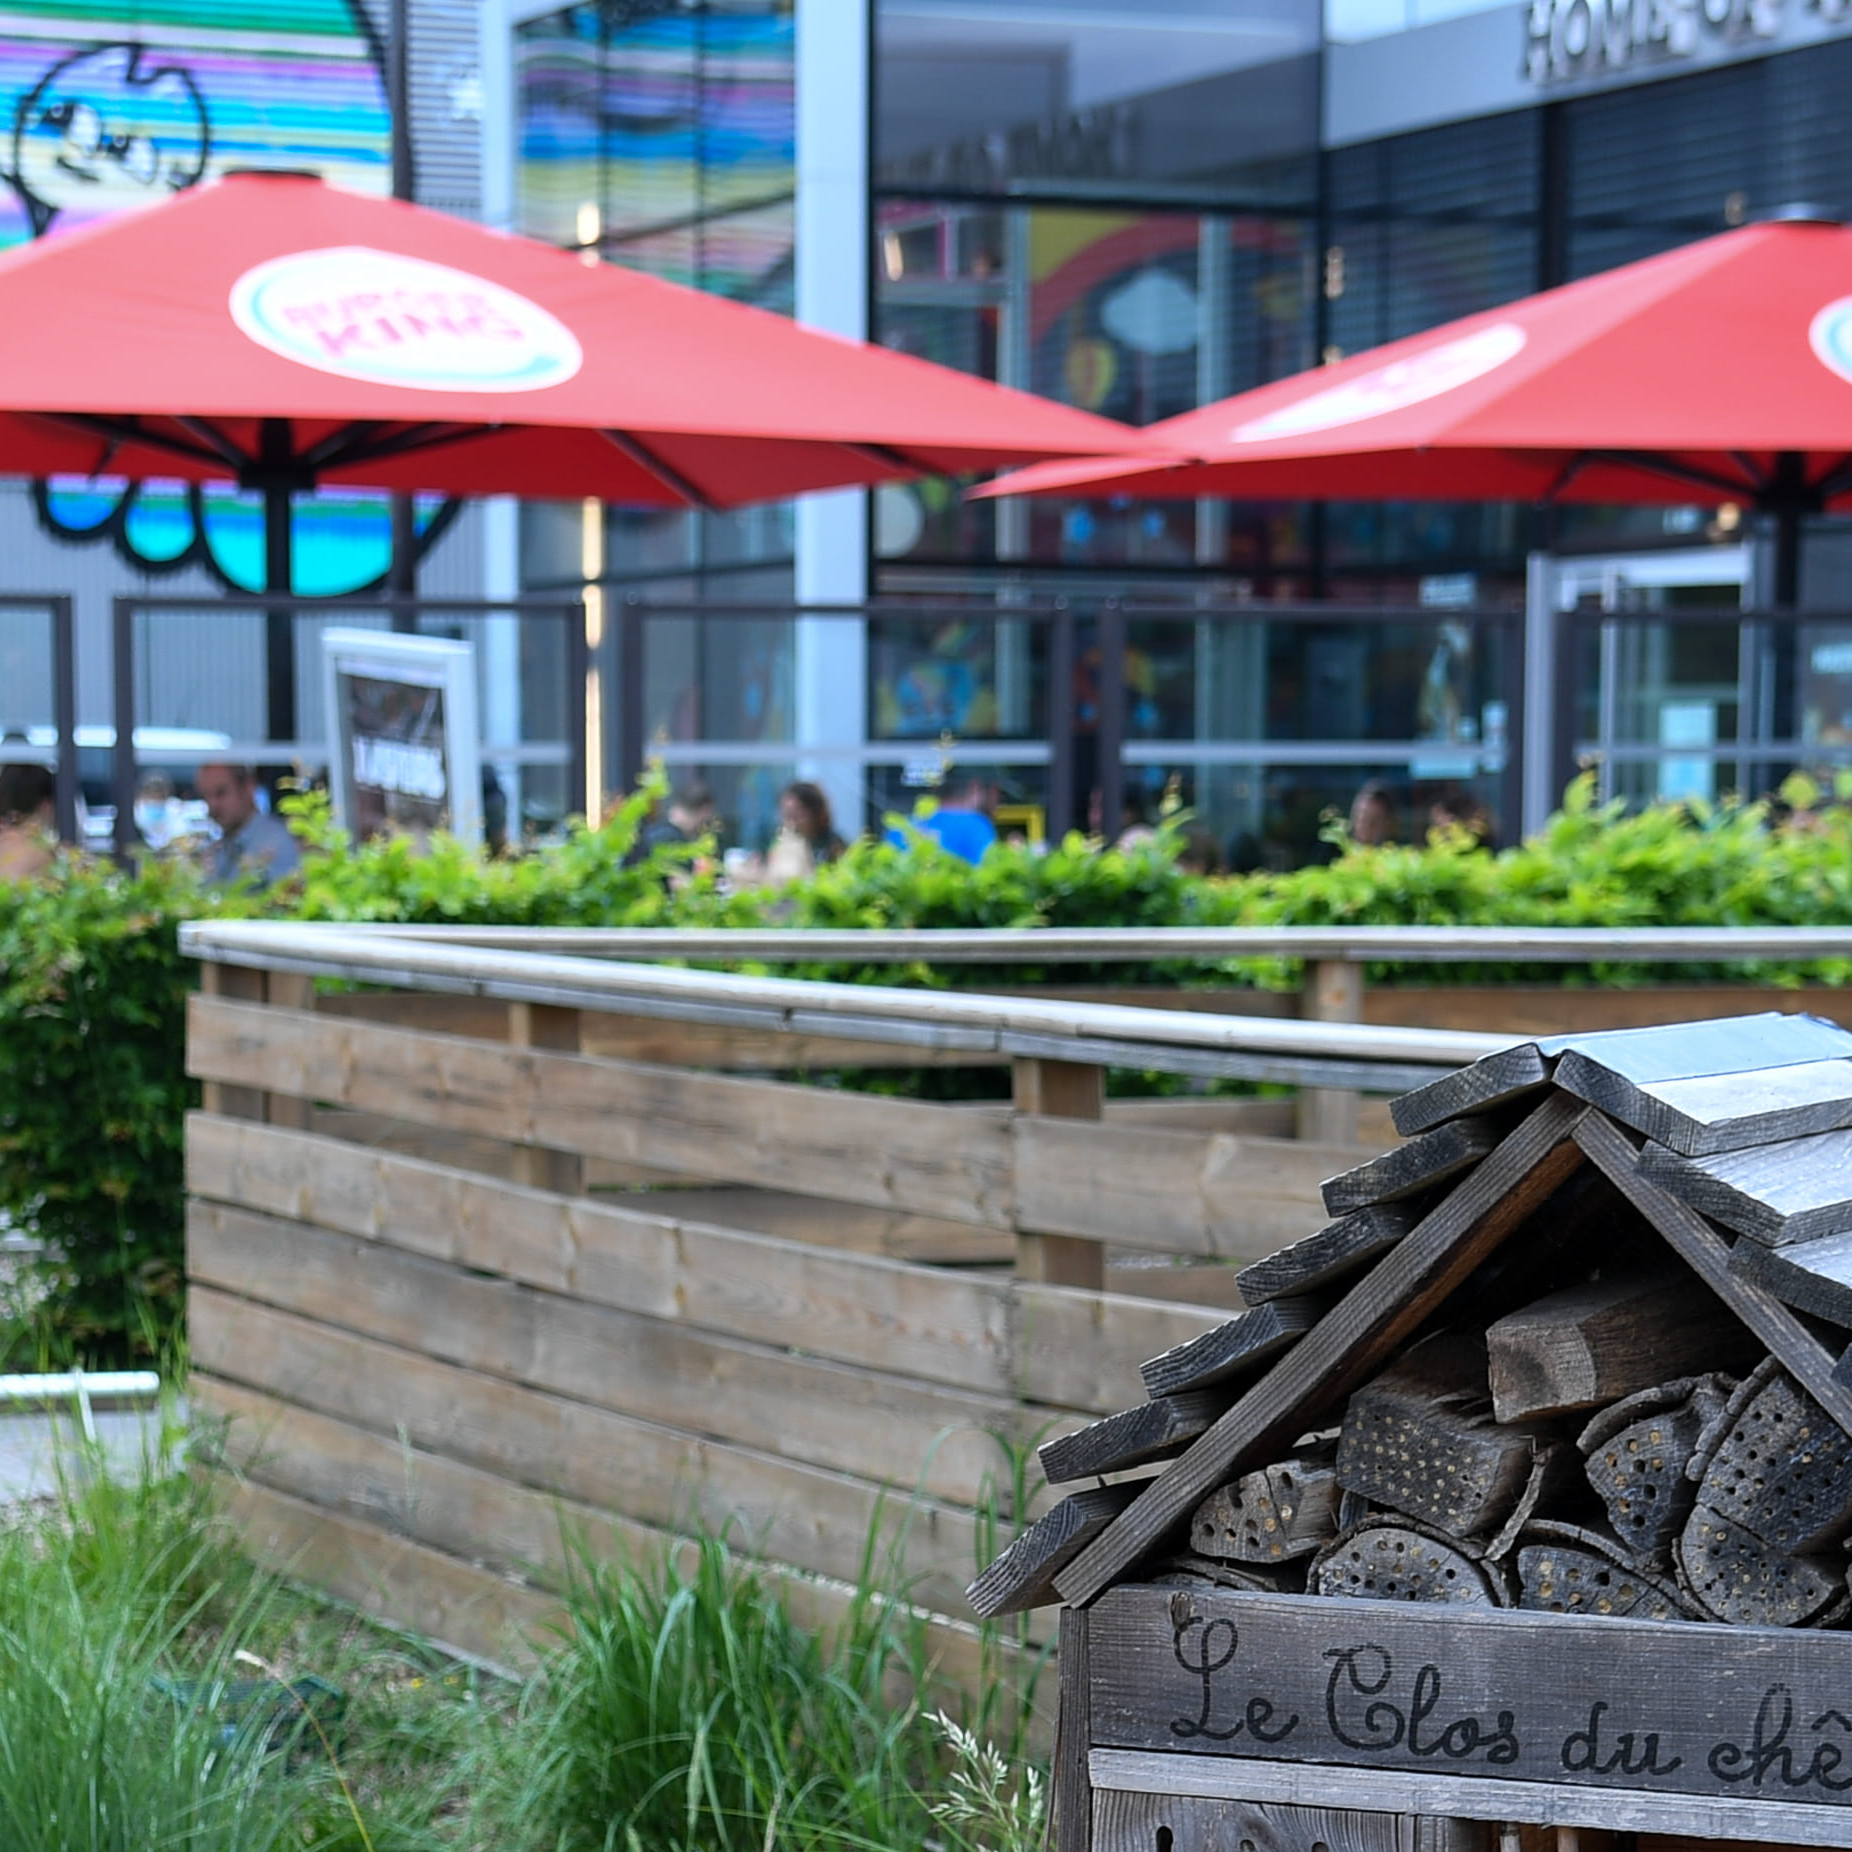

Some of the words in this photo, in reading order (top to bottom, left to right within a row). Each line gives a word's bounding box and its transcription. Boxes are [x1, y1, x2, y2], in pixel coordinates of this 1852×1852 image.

[1170, 1616, 1298, 1742] Le
[1323, 1644, 1520, 1765] Clos
[1561, 1701, 1683, 1775] du
